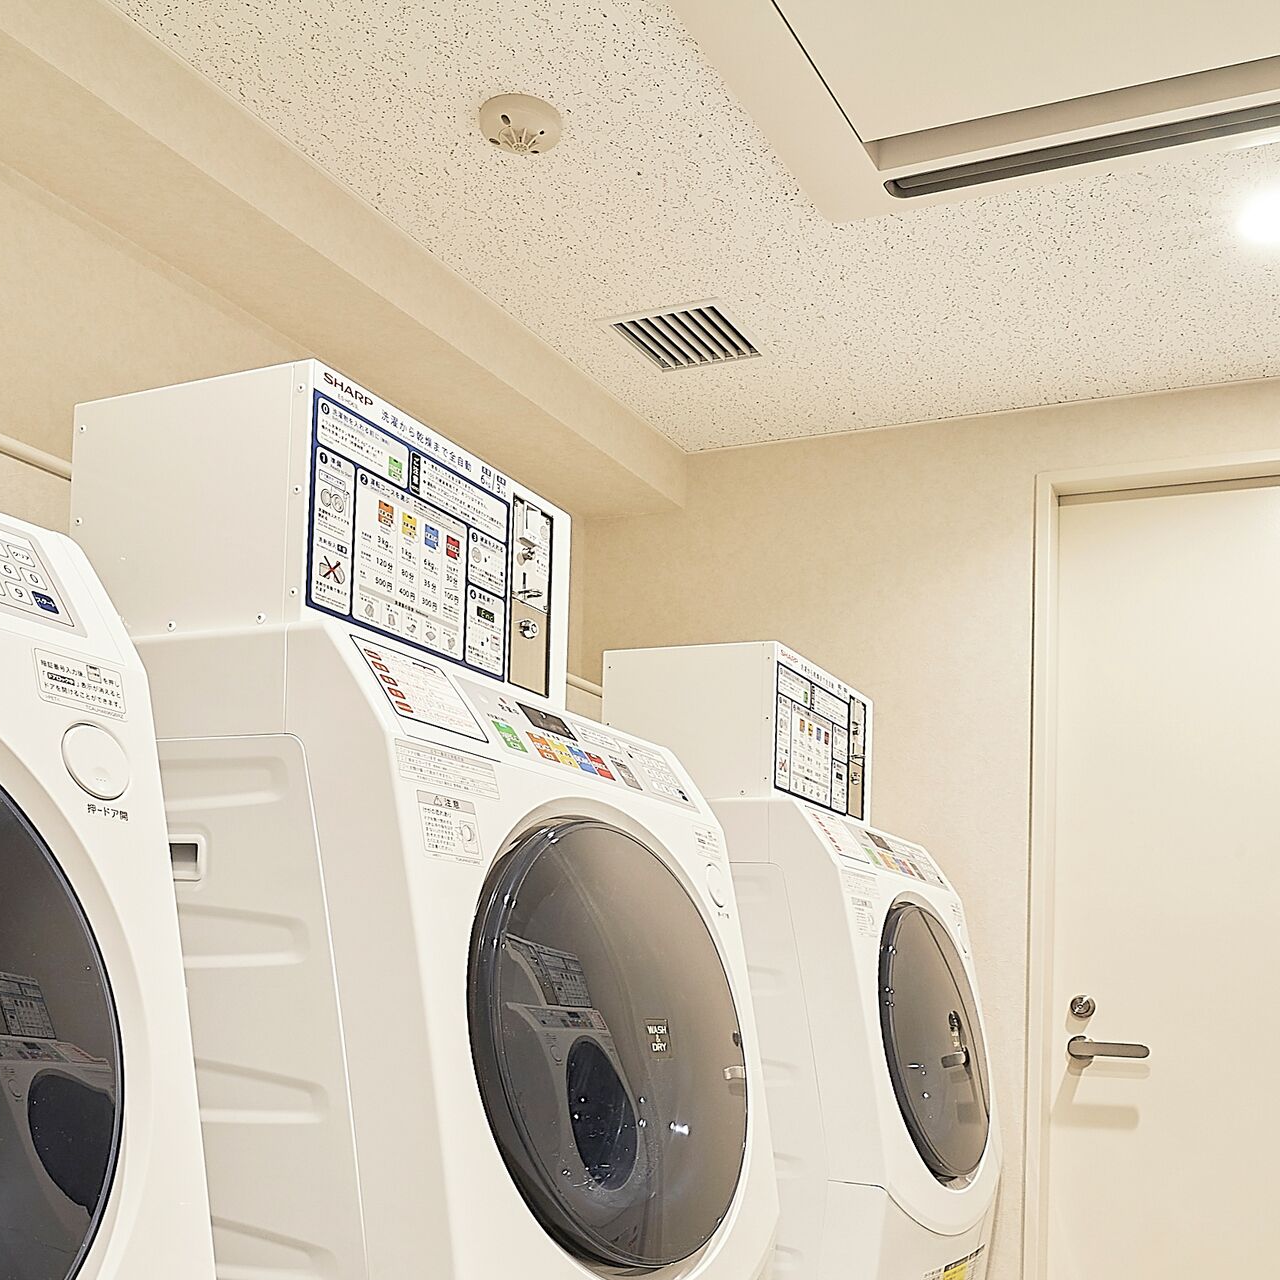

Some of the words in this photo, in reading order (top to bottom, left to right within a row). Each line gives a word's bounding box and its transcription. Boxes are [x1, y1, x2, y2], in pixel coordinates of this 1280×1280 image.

[323, 372, 374, 406] SHARP
[381, 411, 472, 473] 洗濯から乾燥まで全自動
[3, 564, 13, 575] 6
[30, 573, 39, 584] 0
[15, 587, 24, 598] 9
[43, 681, 123, 709] ドアを開けることができます。
[444, 799, 460, 809] 注意
[647, 1025, 667, 1034] WASH
[651, 1042, 667, 1052] DRY
